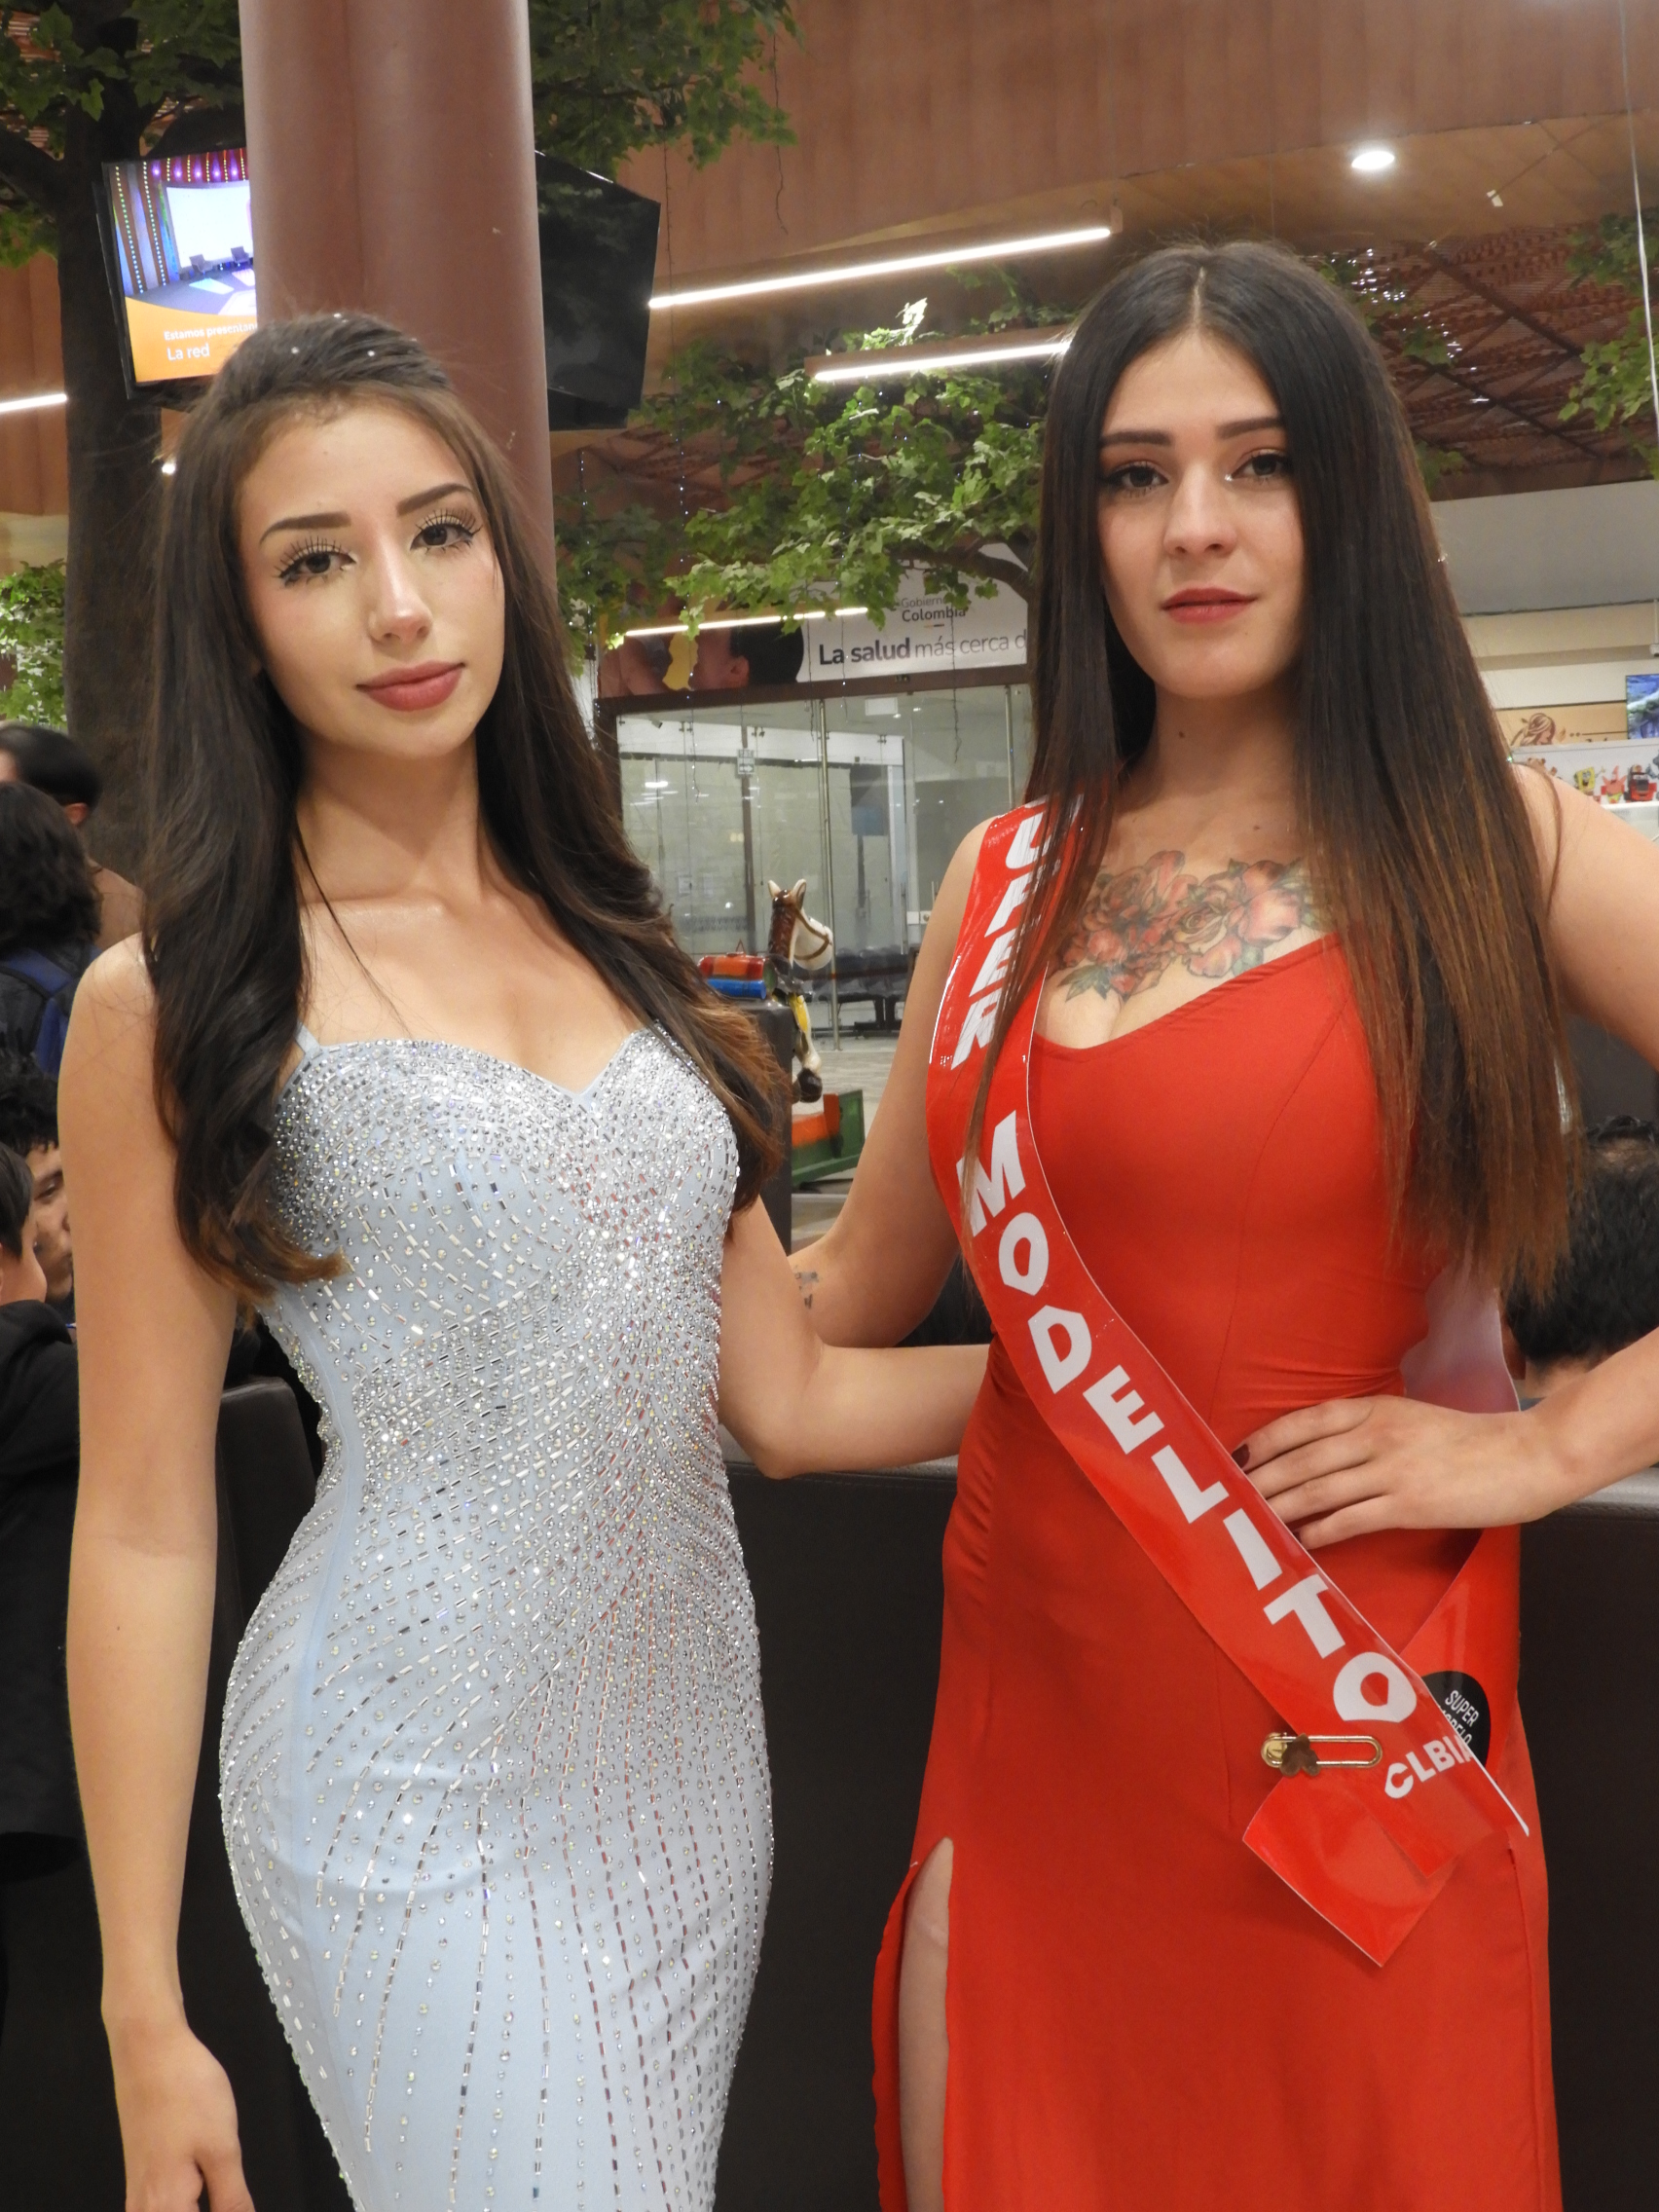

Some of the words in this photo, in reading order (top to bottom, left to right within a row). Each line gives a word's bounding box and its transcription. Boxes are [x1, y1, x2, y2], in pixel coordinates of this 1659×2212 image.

[164, 329, 203, 341] Estamos
[206, 323, 257, 337] presentan
[166, 346, 184, 361] La
[186, 342, 210, 359] red
[901, 596, 943, 608] Gobiern
[902, 606, 966, 622] Colombia
[819, 644, 844, 665] La
[850, 637, 910, 663] salud
[915, 636, 953, 658] más
[959, 635, 1009, 654] cerca
[955, 1109, 1418, 1723] MODELITO
[1445, 1689, 1480, 1727] SUPER
